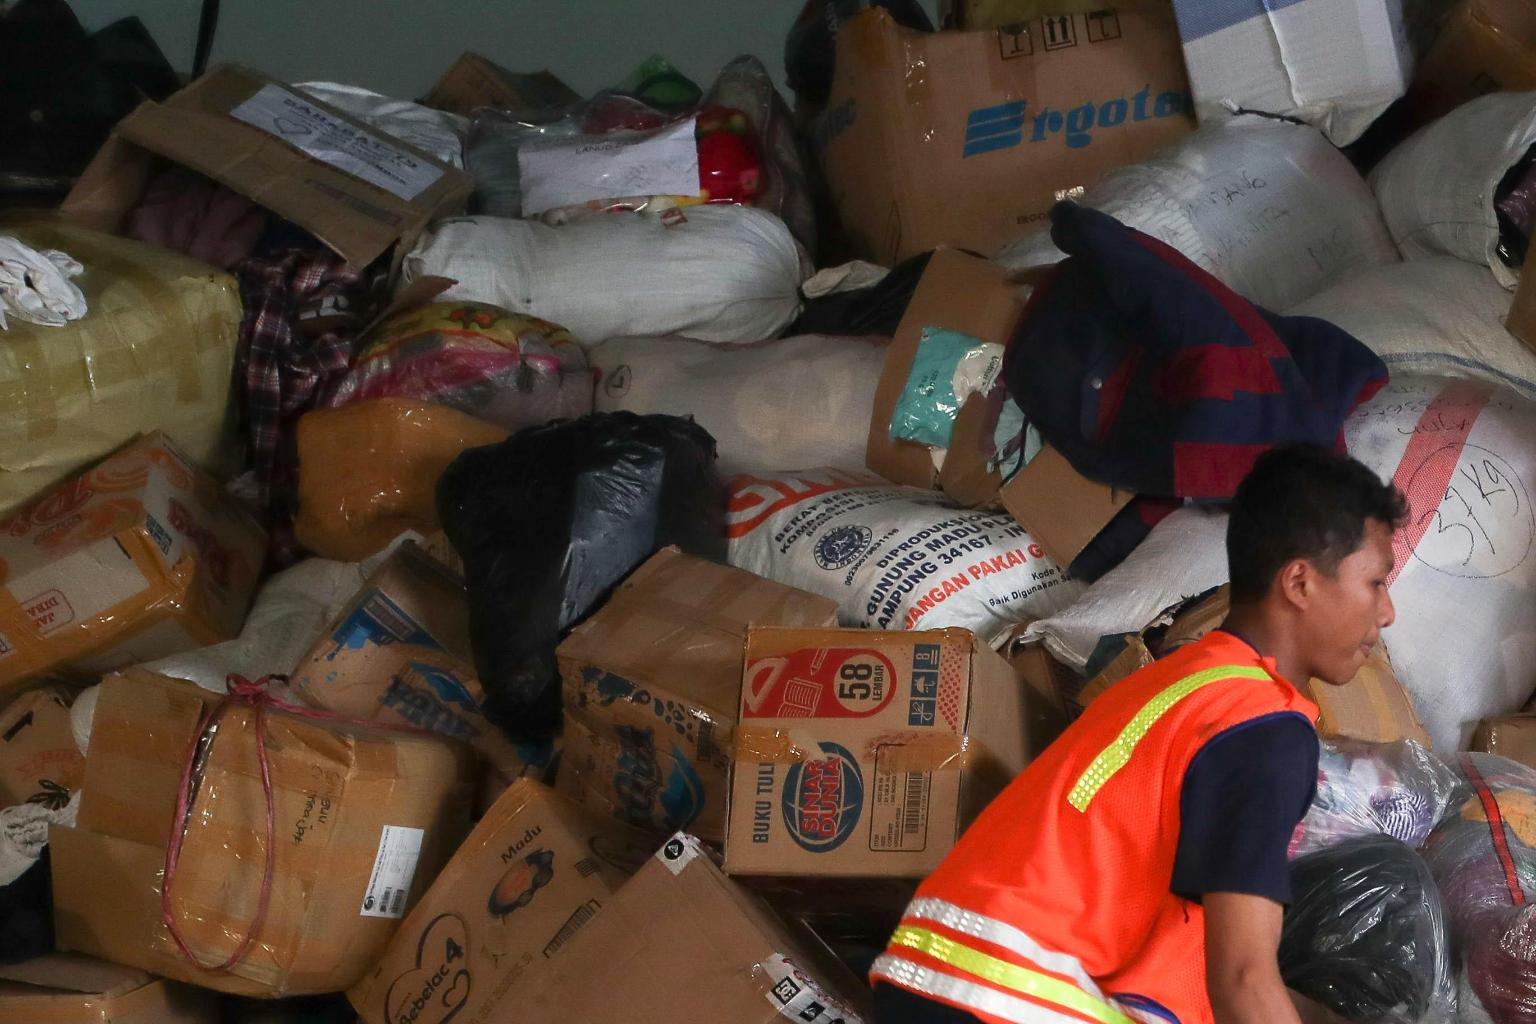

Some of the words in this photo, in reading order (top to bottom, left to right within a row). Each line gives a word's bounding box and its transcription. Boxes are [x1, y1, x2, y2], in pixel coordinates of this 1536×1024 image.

[876, 514, 968, 569] DIPRODUKSI
[1417, 485, 1496, 566] 37
[861, 561, 939, 630] AMPUNG
[943, 534, 994, 566] 34167
[865, 549, 928, 617] GUNUNG
[928, 523, 982, 555] MADU
[904, 571, 970, 630] JANGAN
[971, 548, 1027, 581] PAKAI
[1011, 577, 1060, 602] Digunakan
[838, 663, 873, 701] 58
[872, 665, 885, 701] LEMBAR
[757, 763, 775, 795] TULI
[819, 756, 843, 837] DUNIA
[753, 802, 772, 843] BUKU
[500, 823, 543, 865] Madu
[445, 936, 465, 964] 4
